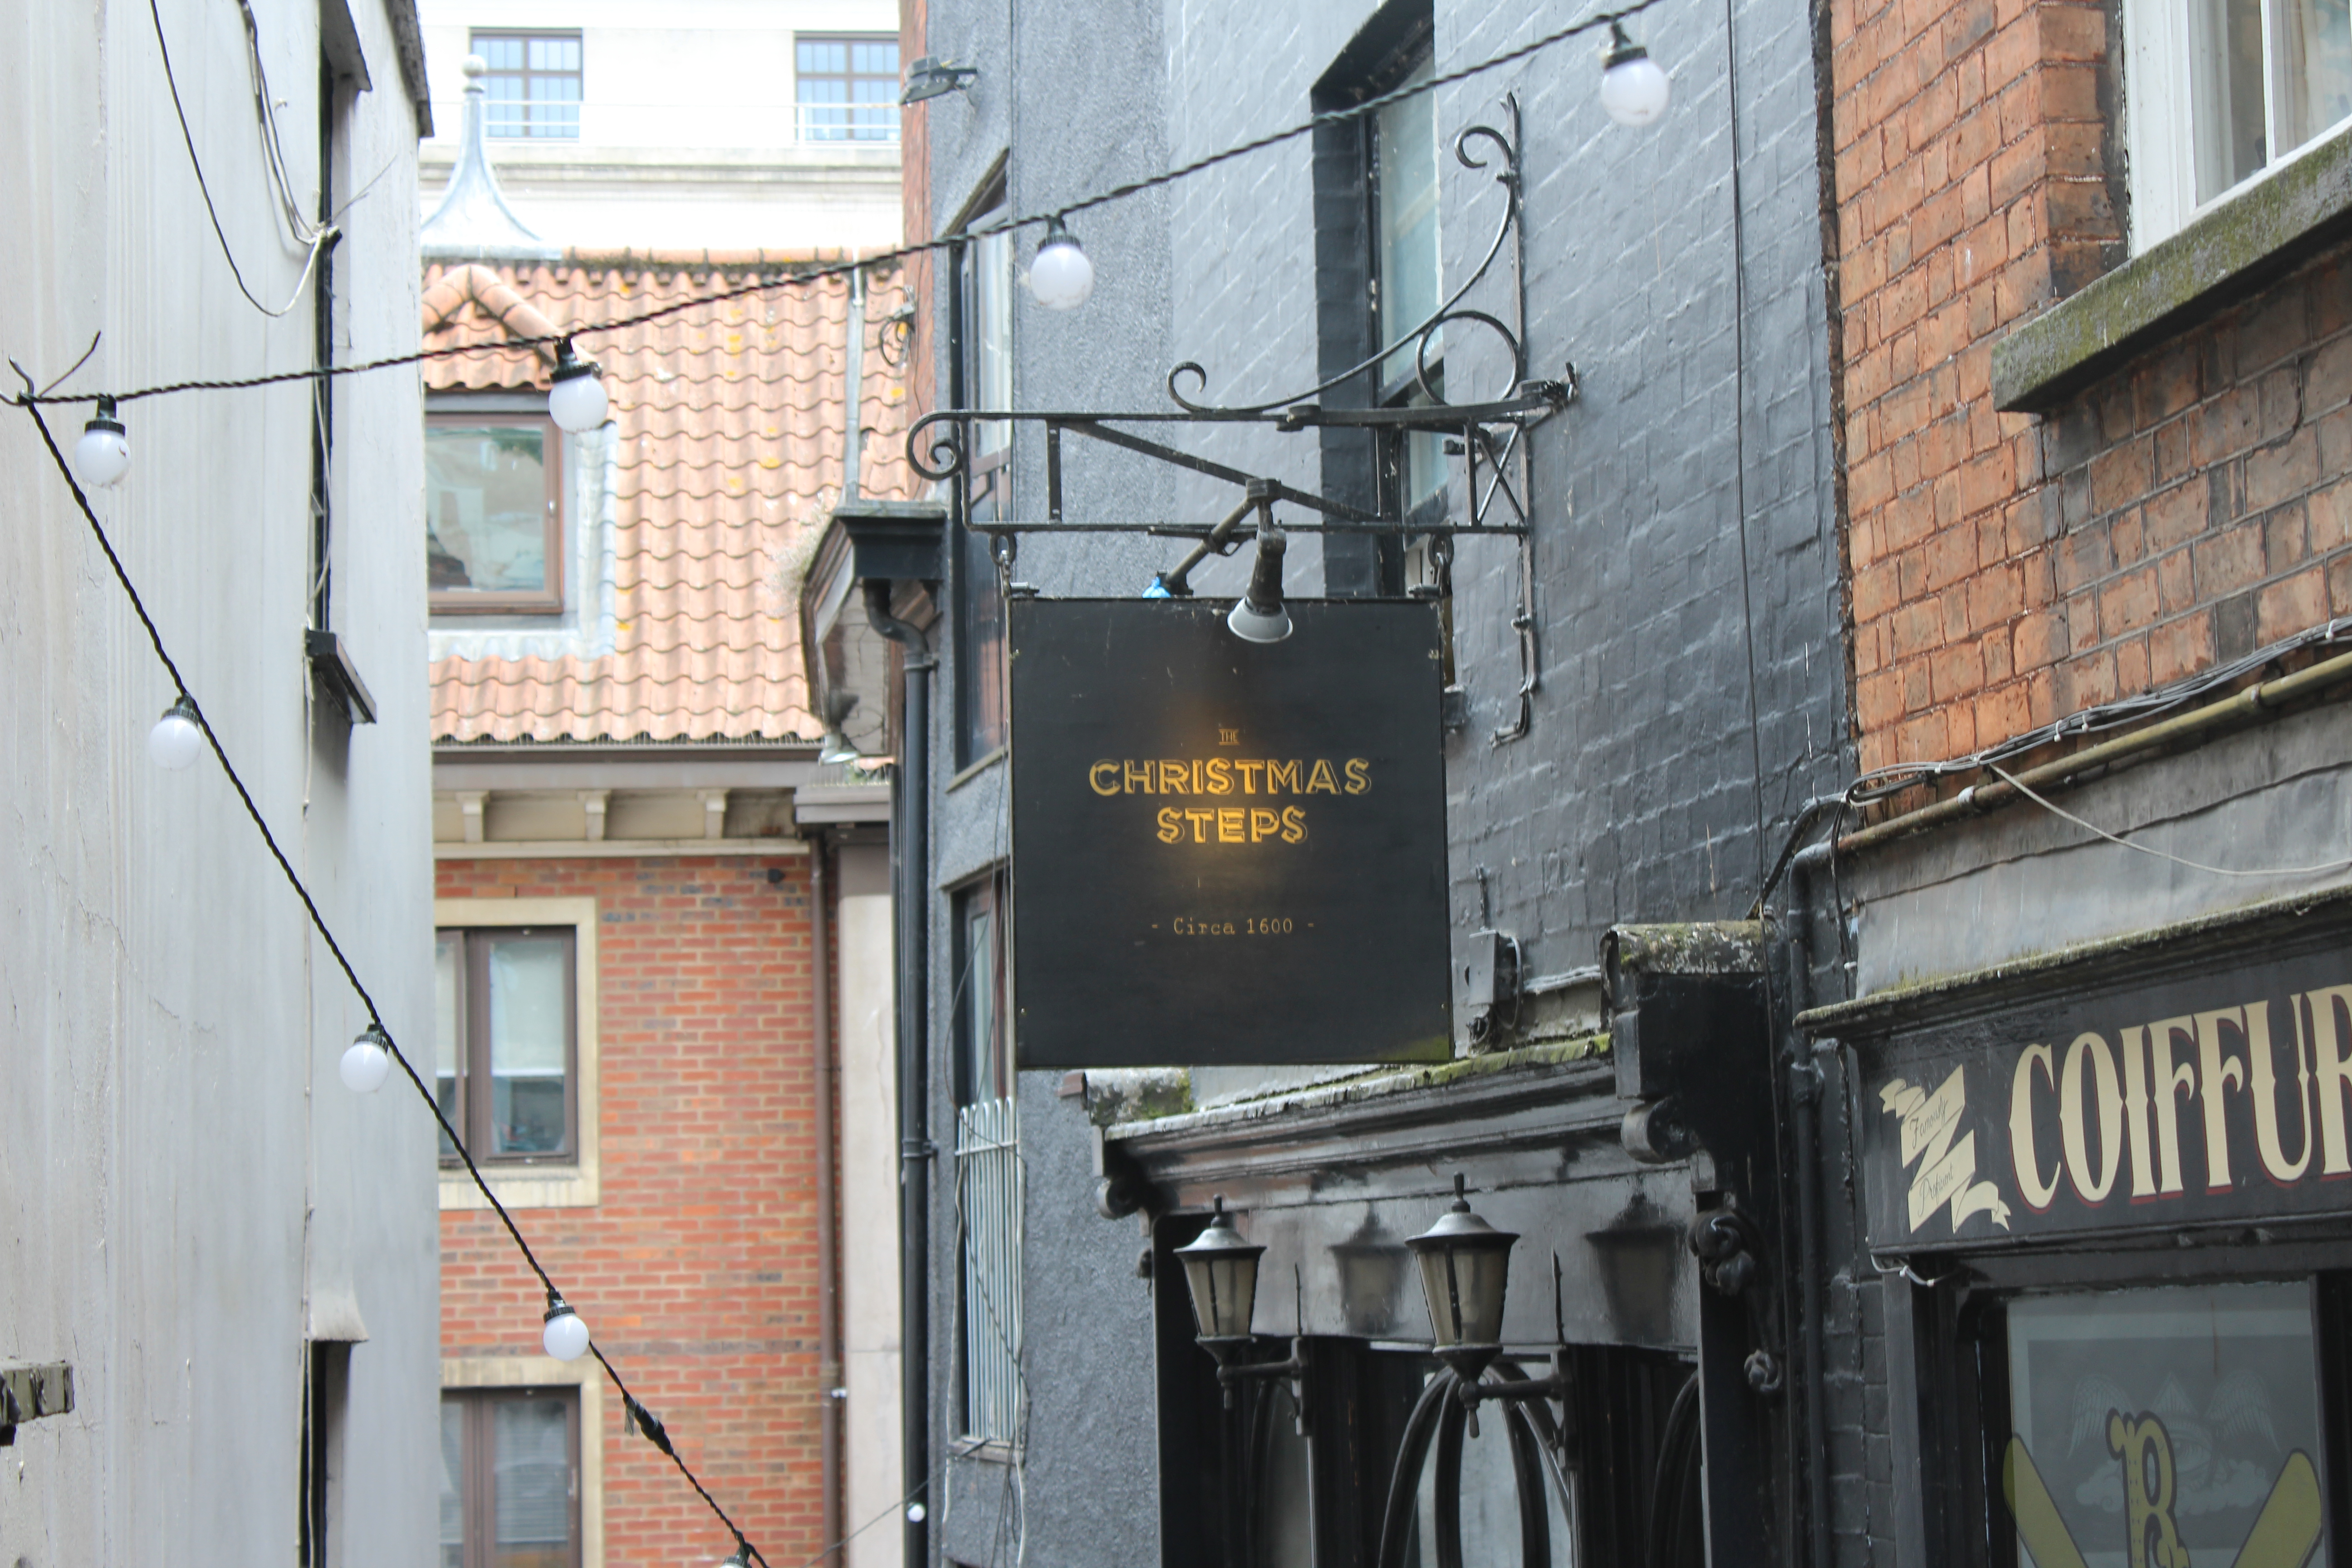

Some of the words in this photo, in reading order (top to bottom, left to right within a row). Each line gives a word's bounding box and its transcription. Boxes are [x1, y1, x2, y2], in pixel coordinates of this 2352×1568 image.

[1219, 729, 1240, 745] THE
[1089, 758, 1372, 796] CHRISTMAS
[1156, 805, 1308, 844] STEPS
[1174, 917, 1235, 936] Circa
[1246, 918, 1293, 935] 1600
[2009, 984, 2352, 1212] COIFFUR
[1910, 1094, 1949, 1149] Famously
[1918, 1161, 1953, 1218] Proficient
